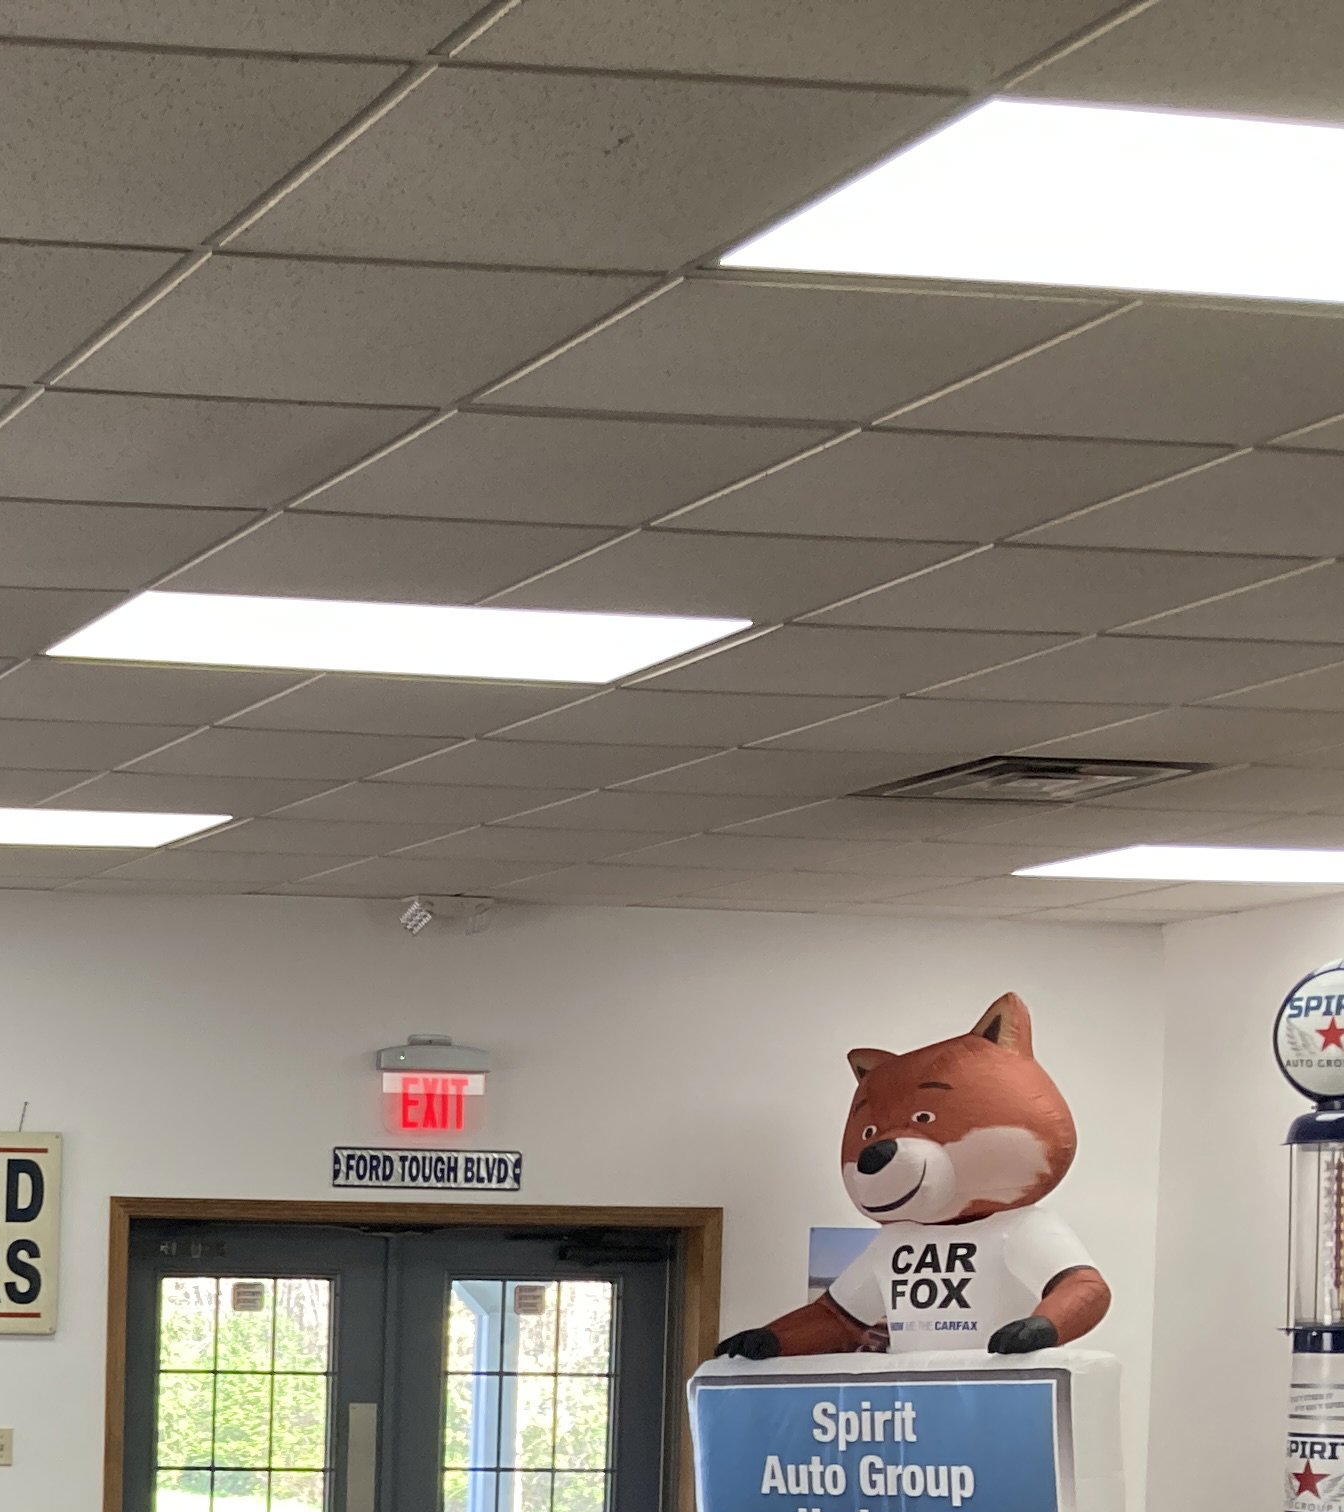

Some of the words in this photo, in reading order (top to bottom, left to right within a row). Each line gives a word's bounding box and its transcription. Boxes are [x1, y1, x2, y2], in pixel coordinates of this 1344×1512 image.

[1286, 1059, 1313, 1068] AUTO
[1317, 1058, 1344, 1068] GRO
[402, 1076, 469, 1129] EXIT
[345, 1154, 394, 1182] FORD
[399, 1155, 458, 1183] TOUGH
[464, 1157, 509, 1184] BLVD
[892, 1242, 977, 1275] CAR
[891, 1278, 973, 1310] FOX
[934, 1321, 978, 1331] CARFAX
[812, 1401, 917, 1451] Spirit
[761, 1455, 847, 1496] Auto
[859, 1455, 975, 1507] Group
